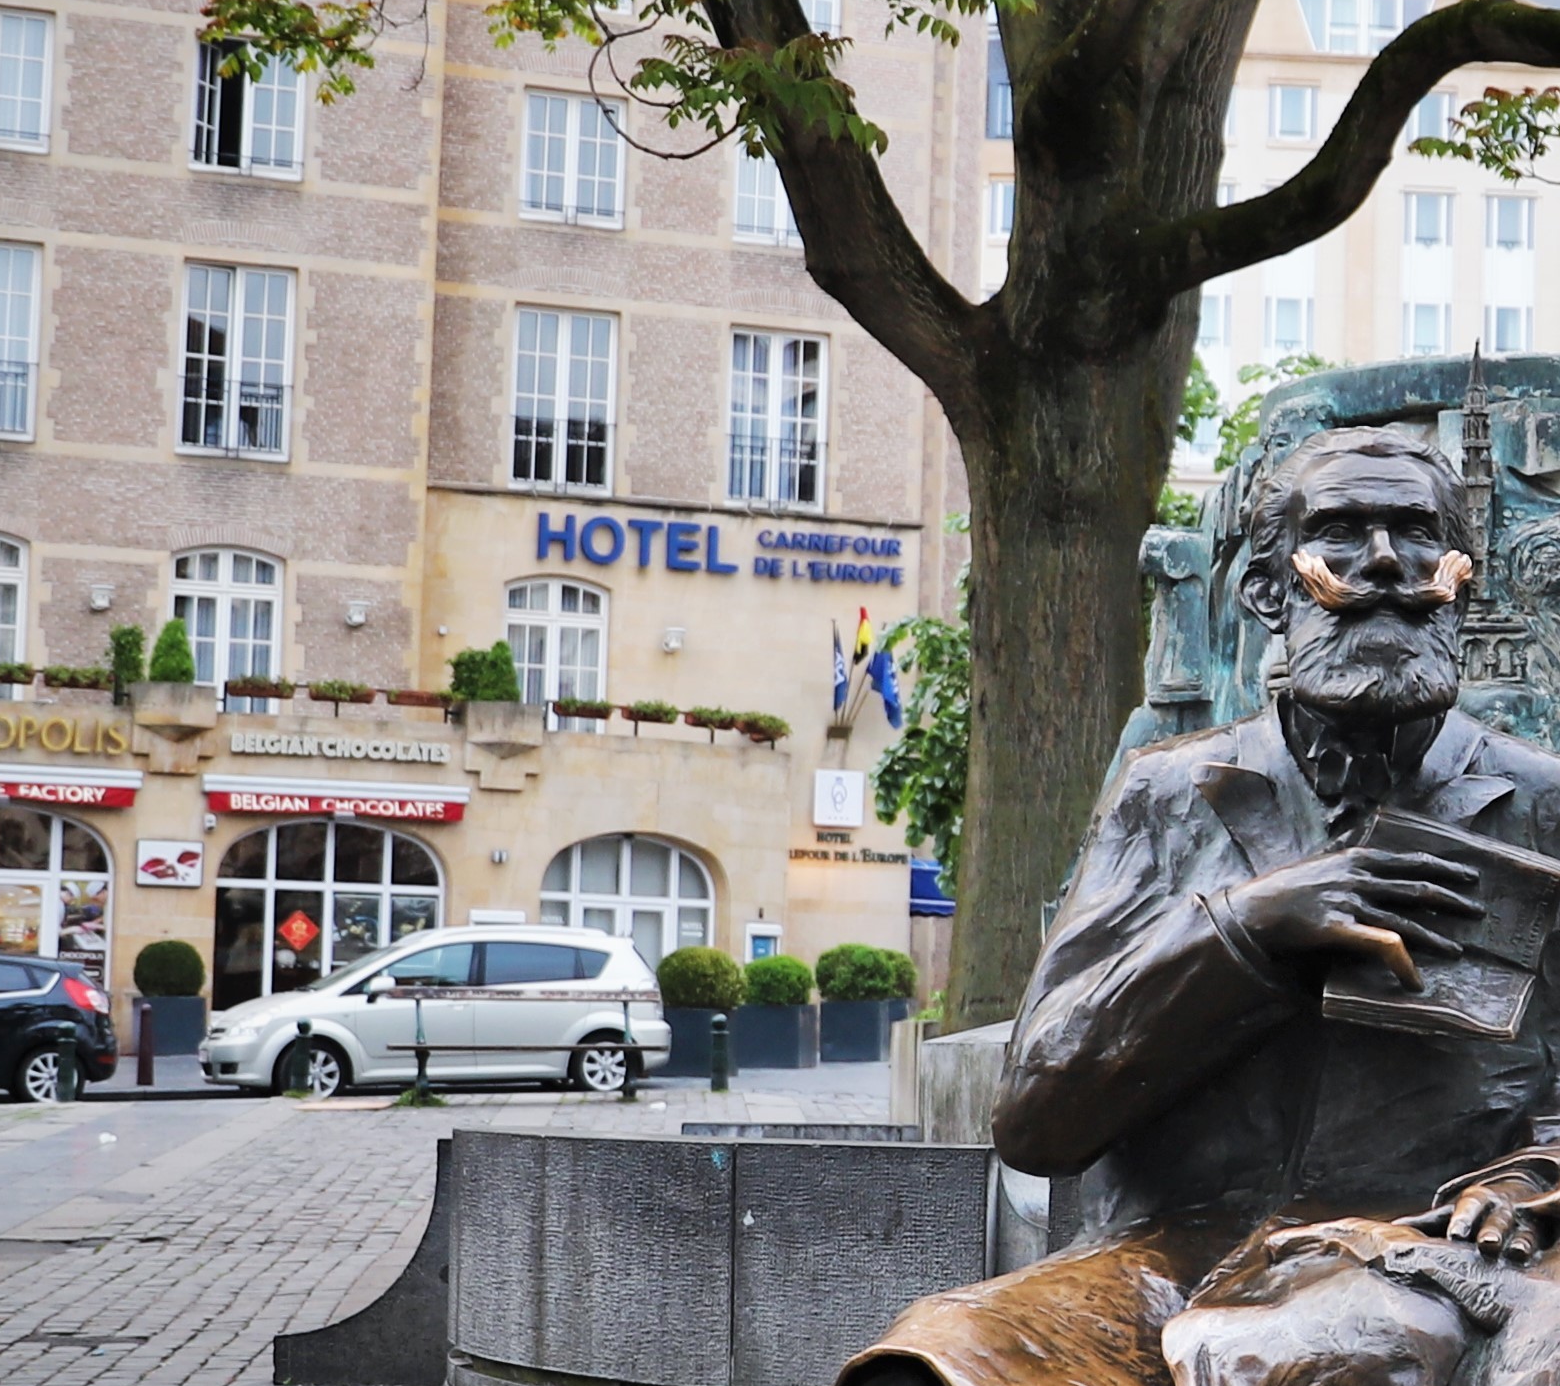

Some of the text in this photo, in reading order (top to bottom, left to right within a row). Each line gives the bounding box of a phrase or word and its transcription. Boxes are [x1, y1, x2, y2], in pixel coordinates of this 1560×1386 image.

[537, 512, 738, 574] HOTEL
[757, 529, 903, 557] CARREFOUR
[753, 556, 905, 587] DE L'EUROPE
[231, 732, 452, 763] BELGIAN CHOCOLATES
[18, 784, 106, 803] FACTORY
[230, 793, 446, 819] BELGIAN CHOCOLATES
[816, 831, 853, 845] HOTEL
